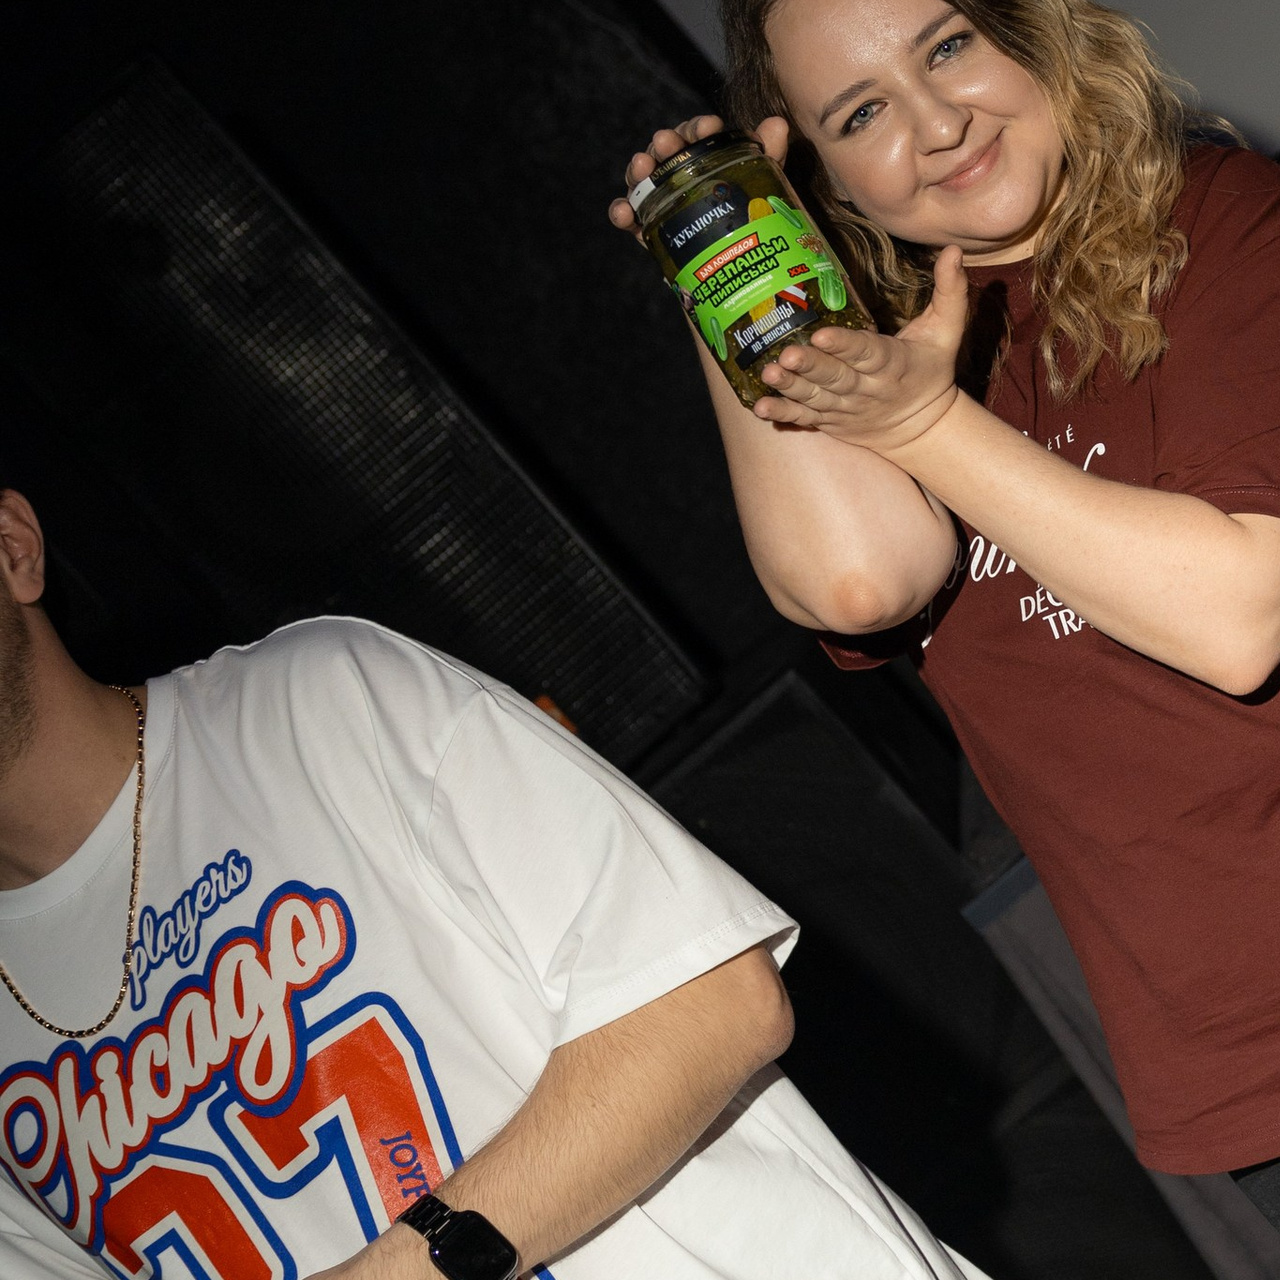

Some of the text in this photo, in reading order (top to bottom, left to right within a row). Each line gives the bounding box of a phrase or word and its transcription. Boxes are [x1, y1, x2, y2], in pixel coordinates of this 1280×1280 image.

[673, 201, 735, 248] КУБАНОЧКА
[693, 237, 788, 303] ЧЕРЕПАШЬИ
[700, 238, 754, 278] ДЛЯ ЛОШПЕДОВ
[711, 257, 778, 306] ПИПИСЬКИ
[788, 264, 809, 277] XXL
[123, 850, 252, 1010] players
[0, 885, 354, 1255] Chicago
